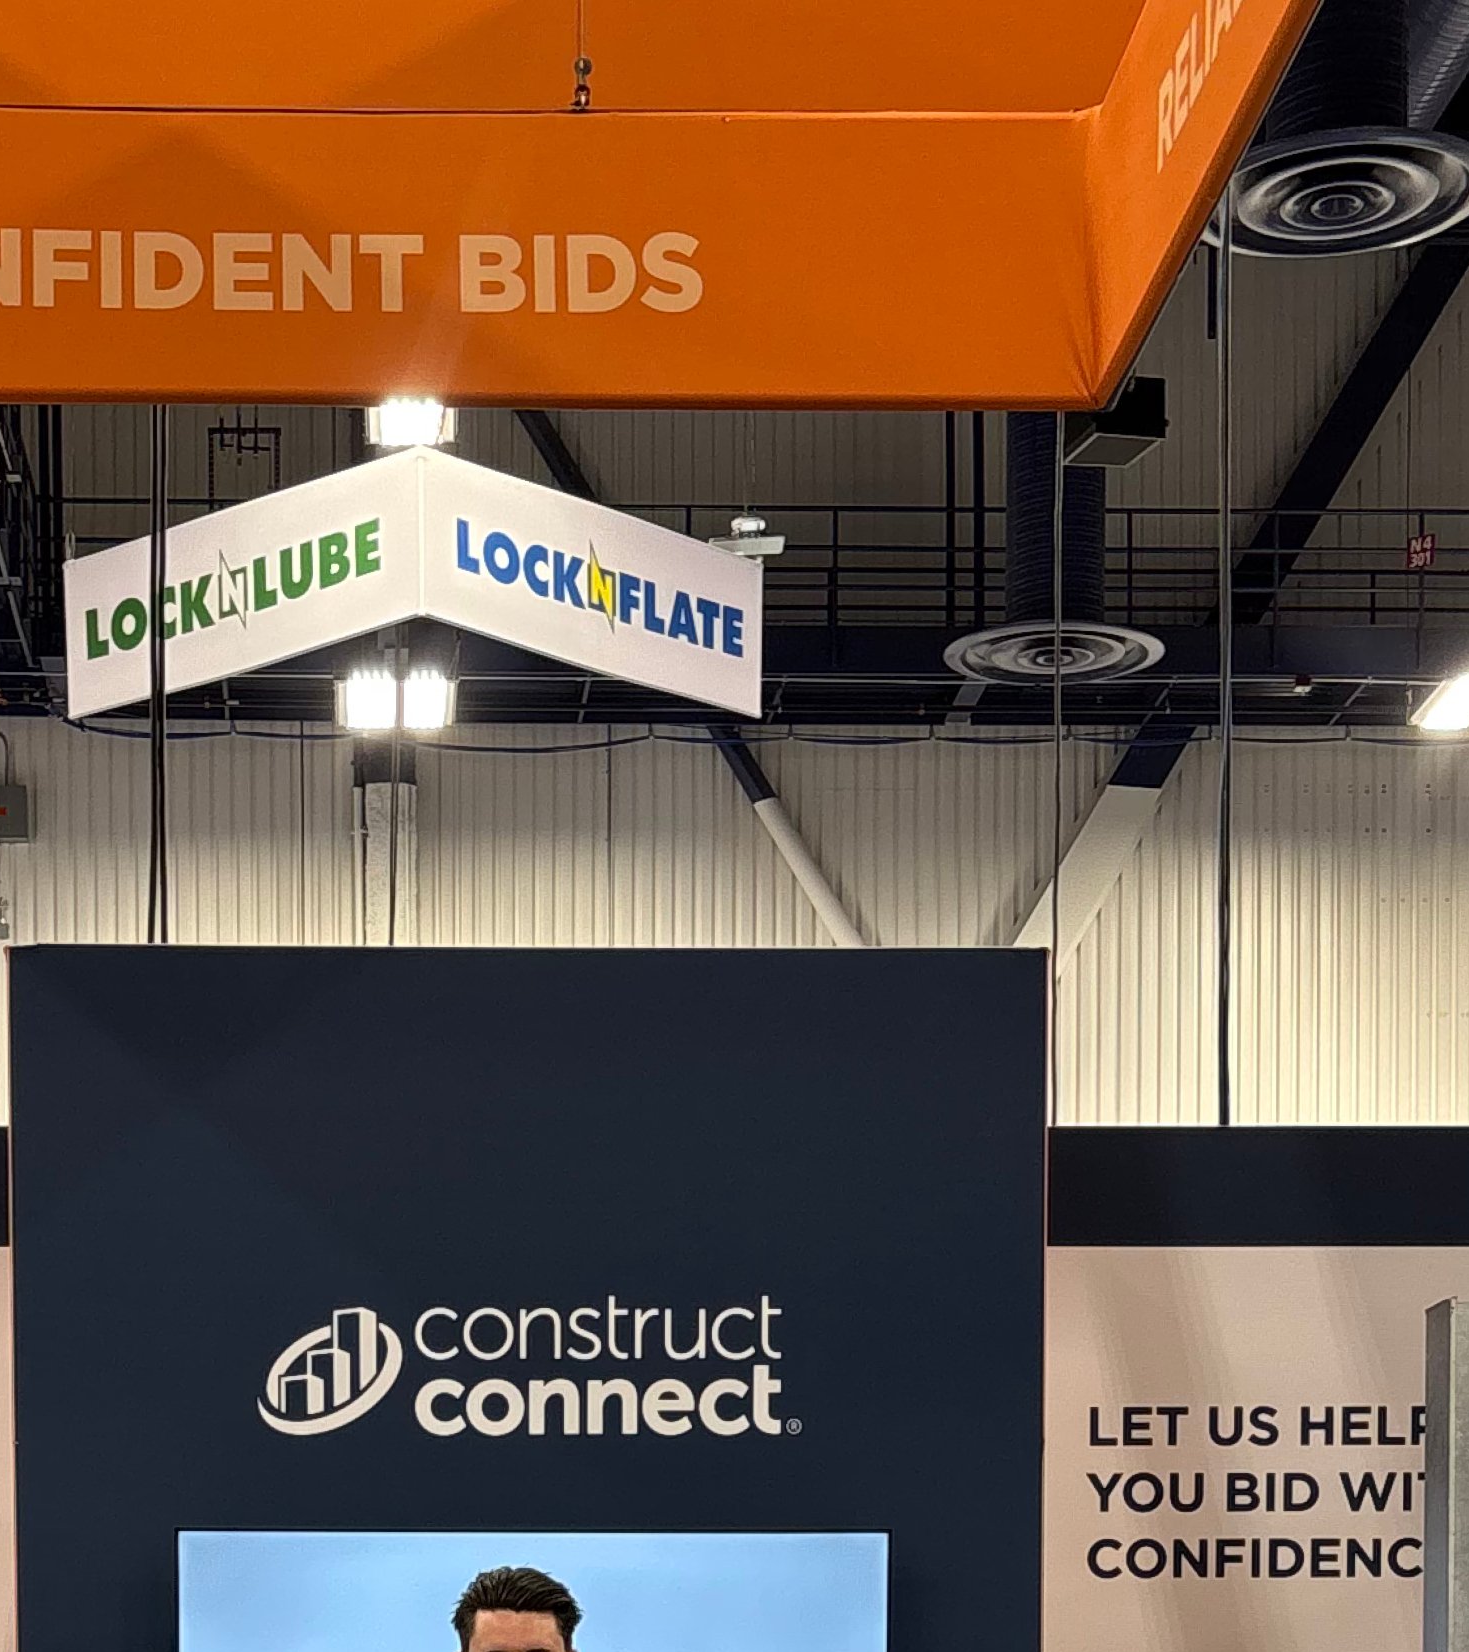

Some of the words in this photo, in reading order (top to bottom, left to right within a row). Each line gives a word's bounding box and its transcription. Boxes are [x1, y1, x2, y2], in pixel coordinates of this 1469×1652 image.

[459, 231, 704, 313] BIDS
[1410, 535, 1432, 553] N4
[415, 1295, 782, 1361] construct
[1089, 1406, 1189, 1447] LET
[1208, 1406, 1279, 1447] US
[1087, 1472, 1205, 1513] YOU
[1226, 1472, 1320, 1513] BID
[1339, 1472, 1425, 1512] WI
